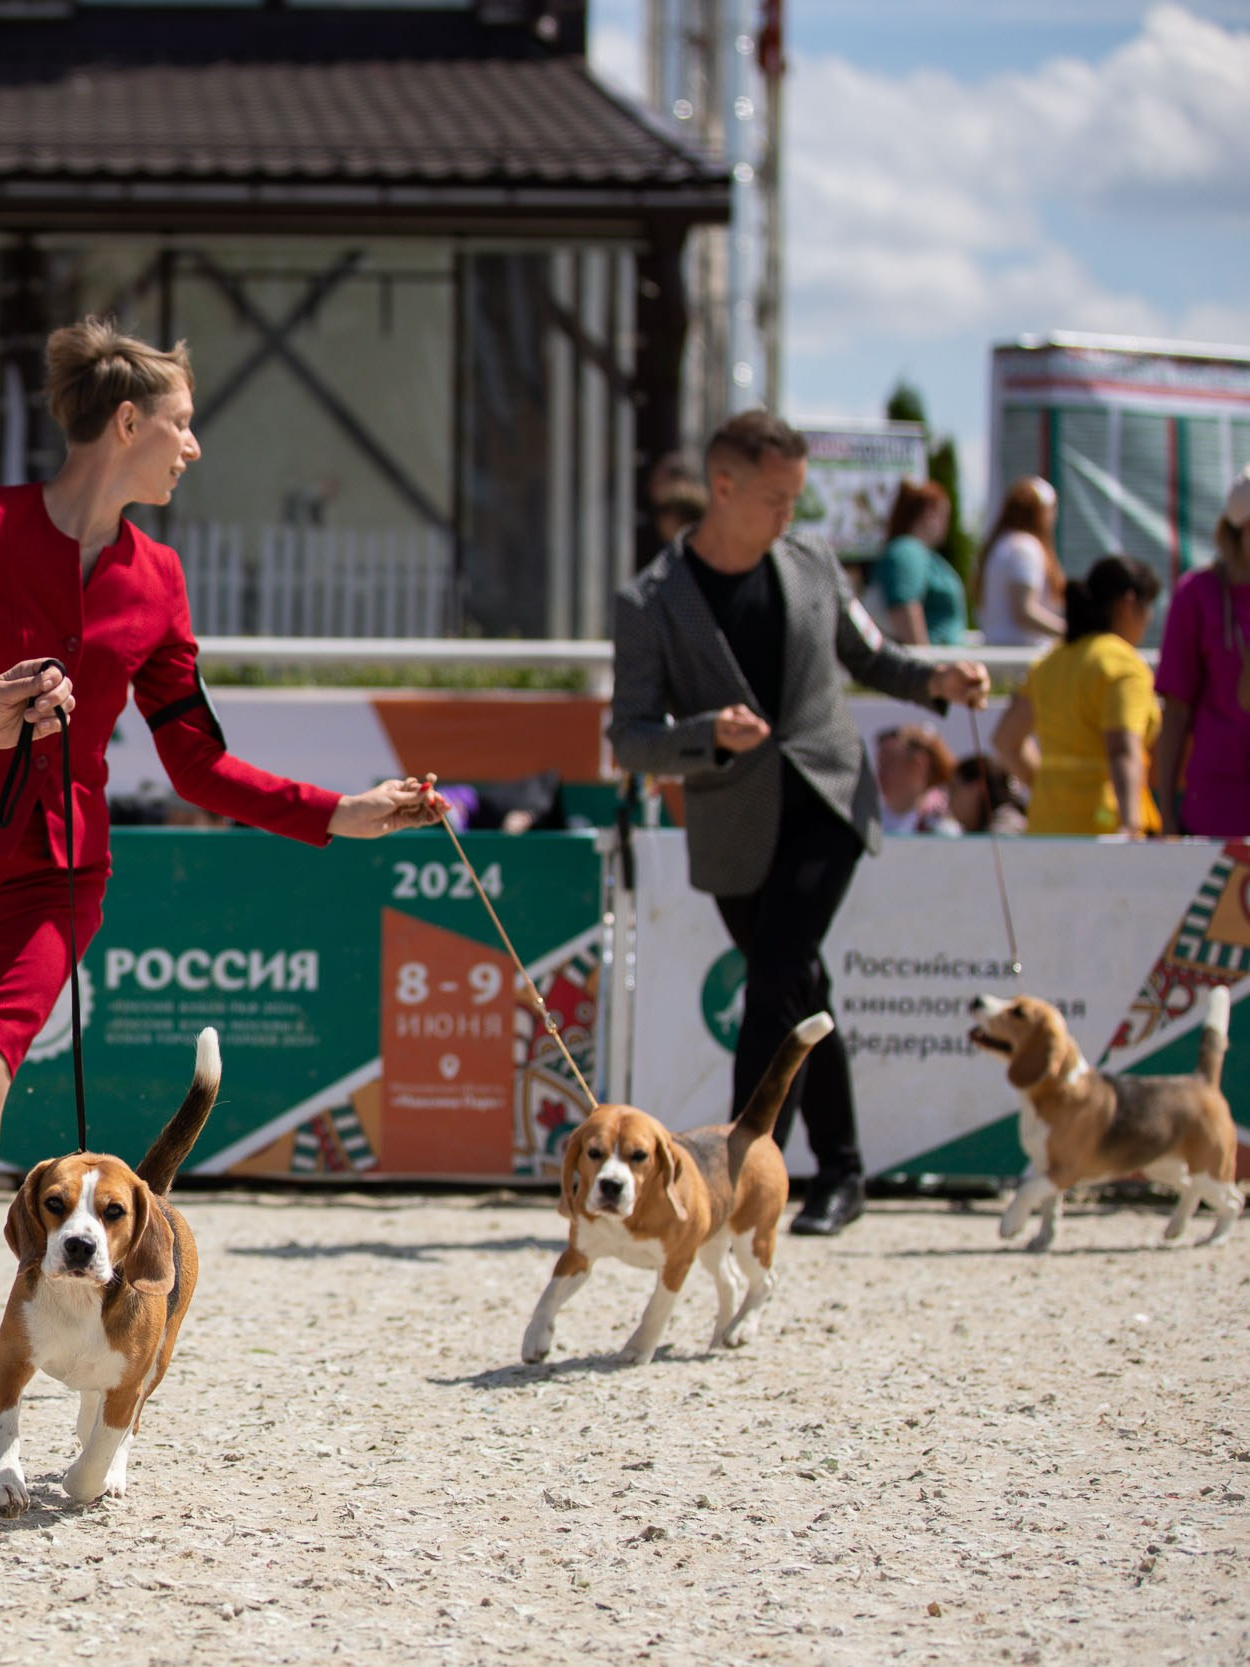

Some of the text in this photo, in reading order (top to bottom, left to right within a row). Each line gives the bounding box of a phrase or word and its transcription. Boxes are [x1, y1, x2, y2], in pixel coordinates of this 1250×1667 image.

[393, 861, 503, 899] 2024
[106, 949, 318, 991] РОССИЯ
[844, 950, 1018, 979] Российская
[397, 1012, 503, 1037] ИЮНЯ
